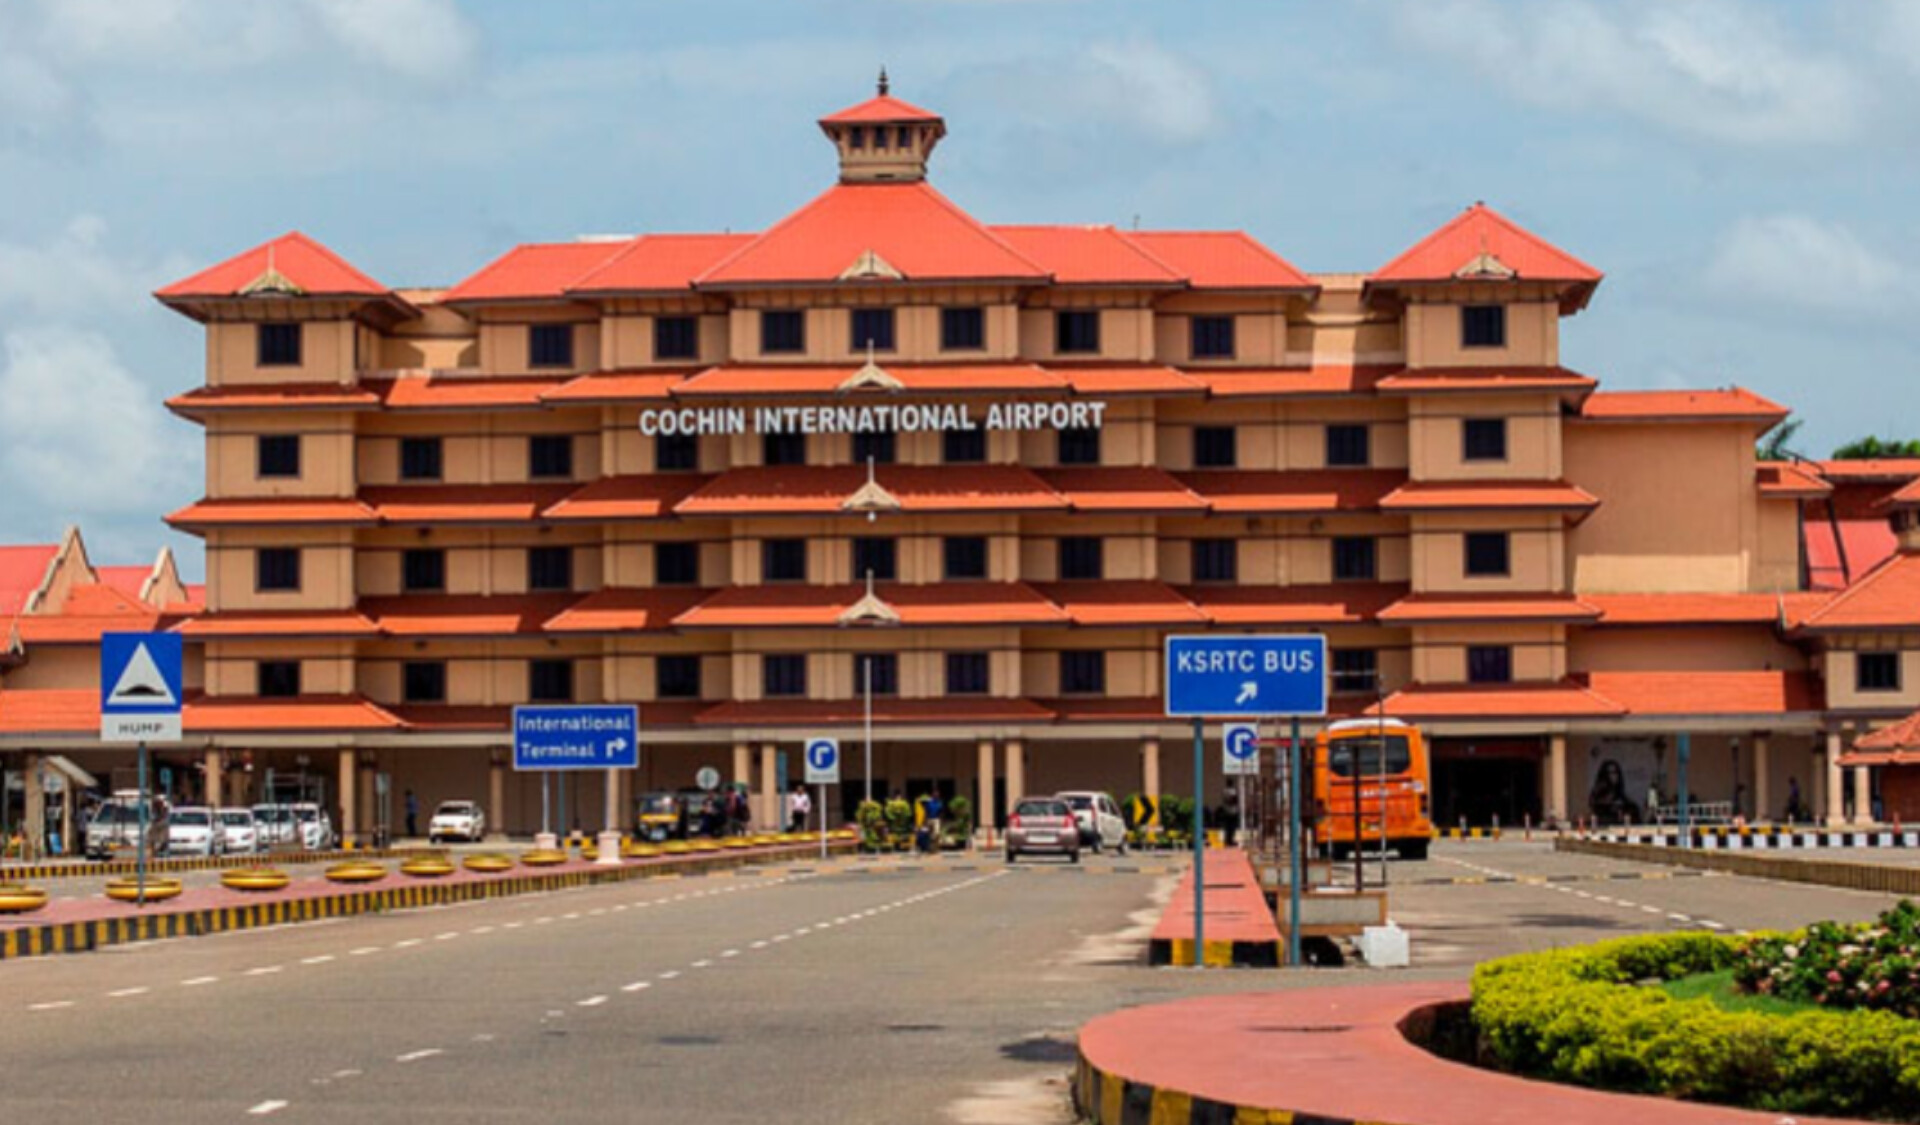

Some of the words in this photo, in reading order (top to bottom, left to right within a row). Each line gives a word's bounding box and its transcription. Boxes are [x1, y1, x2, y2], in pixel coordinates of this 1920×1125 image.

[639, 407, 745, 435] COCHIN
[754, 405, 976, 433] INTERNATIONAL
[986, 402, 1106, 430] AIRPORT
[1178, 649, 1255, 672] KSRTC
[1264, 649, 1314, 672] BUS
[118, 722, 163, 734] HUMP
[519, 715, 631, 731] International
[521, 741, 595, 758] Terminal
